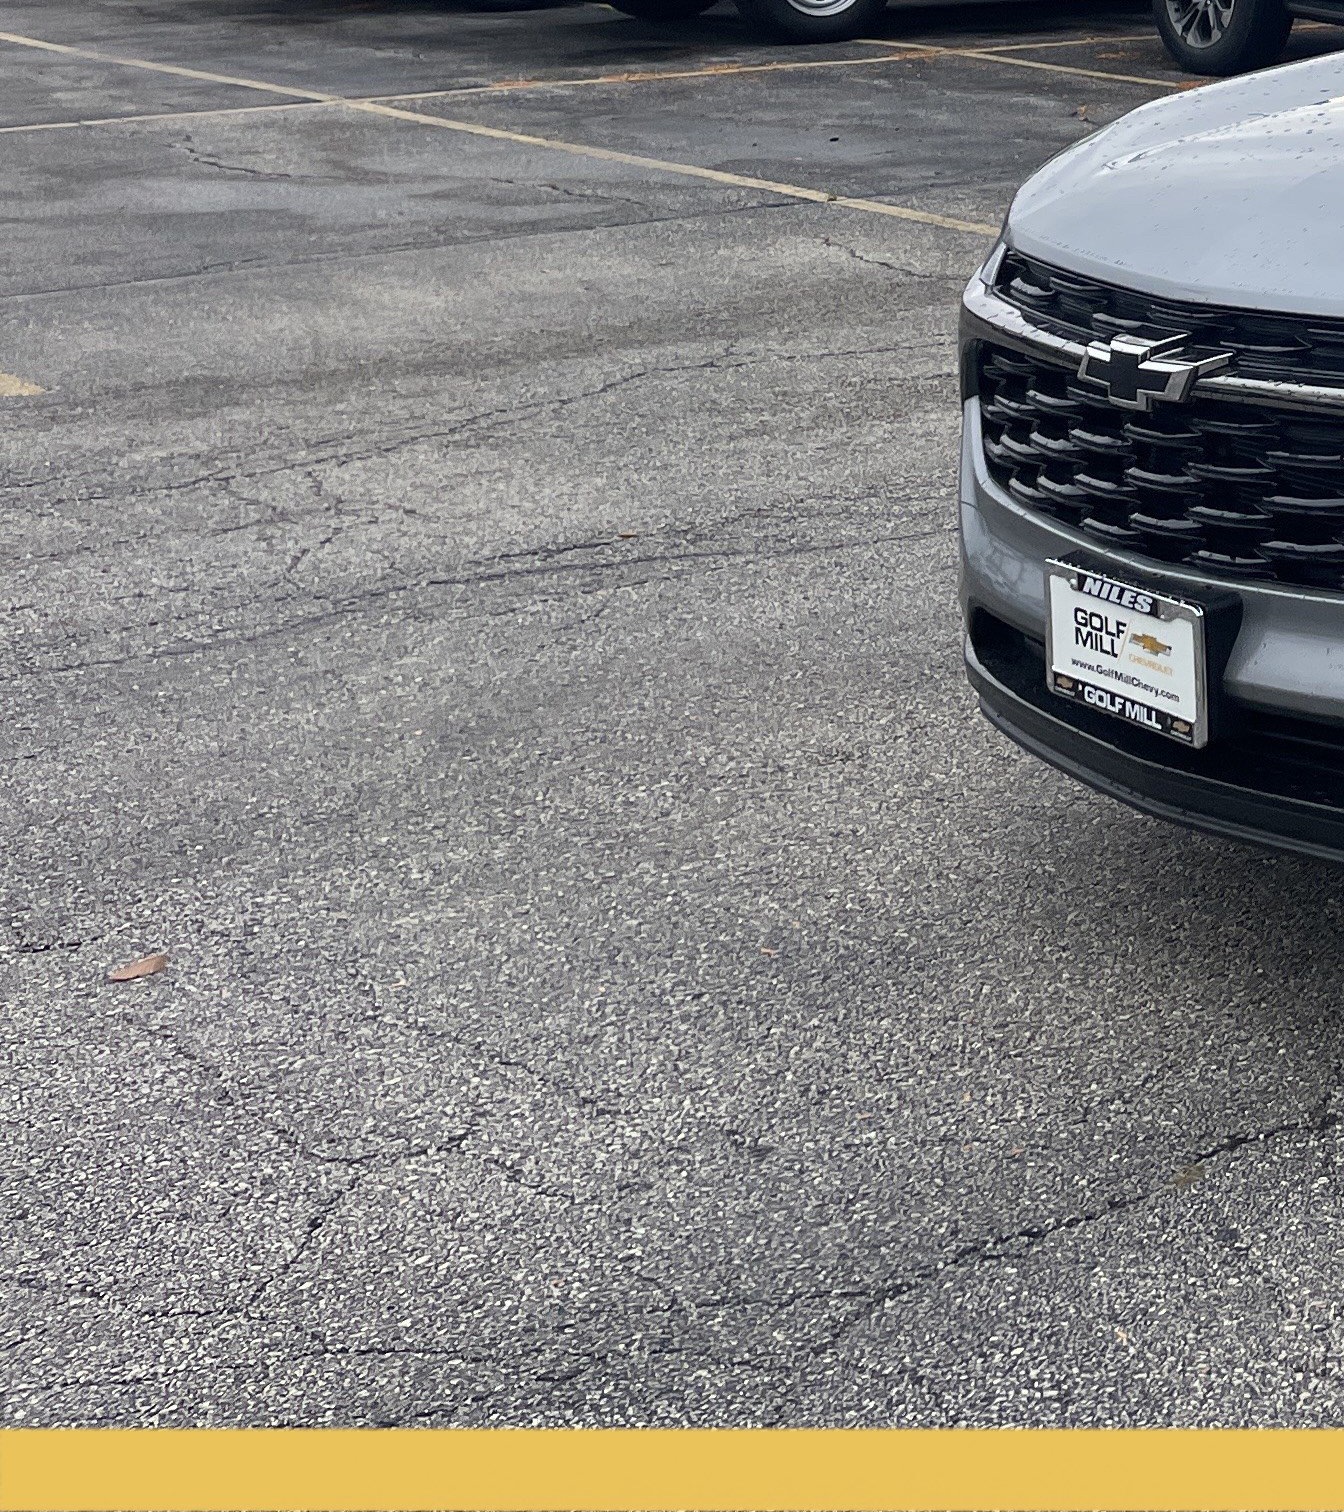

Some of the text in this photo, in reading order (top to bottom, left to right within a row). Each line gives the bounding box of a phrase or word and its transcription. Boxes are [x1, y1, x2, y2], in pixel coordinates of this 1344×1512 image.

[1082, 576, 1153, 614] NILES
[1073, 606, 1127, 639] GOLF
[1074, 626, 1119, 658] MILL
[1070, 657, 1180, 703] www.GolfMillChevy.com
[1083, 685, 1163, 730] GOLF MILL
